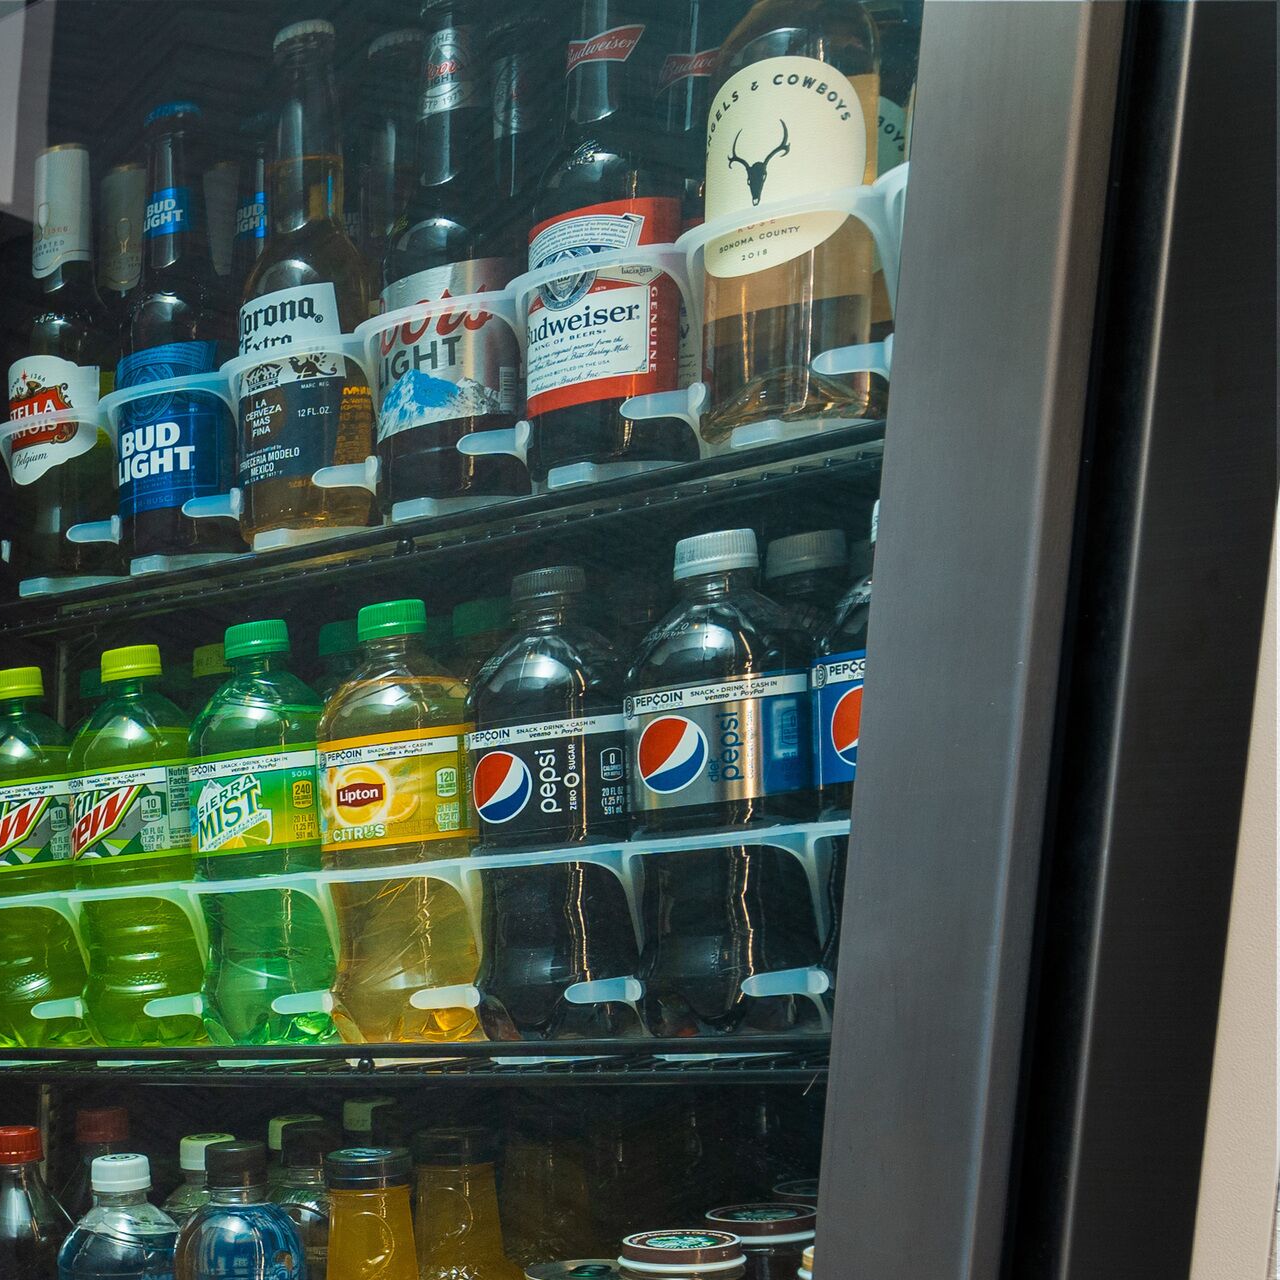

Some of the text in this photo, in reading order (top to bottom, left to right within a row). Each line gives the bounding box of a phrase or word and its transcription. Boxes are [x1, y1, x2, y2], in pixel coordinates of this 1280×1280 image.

[773, 74, 851, 122] COWBOYS
[719, 225, 800, 254] SONOMA COUNTY
[741, 248, 768, 262] 2018
[527, 303, 640, 348] Budweiser
[649, 286, 658, 373] GENUINE
[246, 404, 282, 422] CERVEZA
[121, 422, 181, 458] BUD
[252, 427, 271, 438] FINA
[14, 451, 48, 468] Belgium
[118, 445, 195, 487] LIGHT
[704, 689, 766, 702] venmo PayPal
[715, 710, 745, 782] pepsi
[291, 769, 312, 778] SODA
[439, 771, 454, 783] 120
[534, 748, 562, 814] pepsi
[568, 743, 577, 811] ZERO SUGAR
[198, 774, 257, 819] SIERRA
[294, 784, 311, 795] 240
[339, 788, 379, 804] Lipton
[146, 798, 157, 809] 10
[199, 781, 261, 848] MIST
[332, 825, 386, 842] CITRUS
